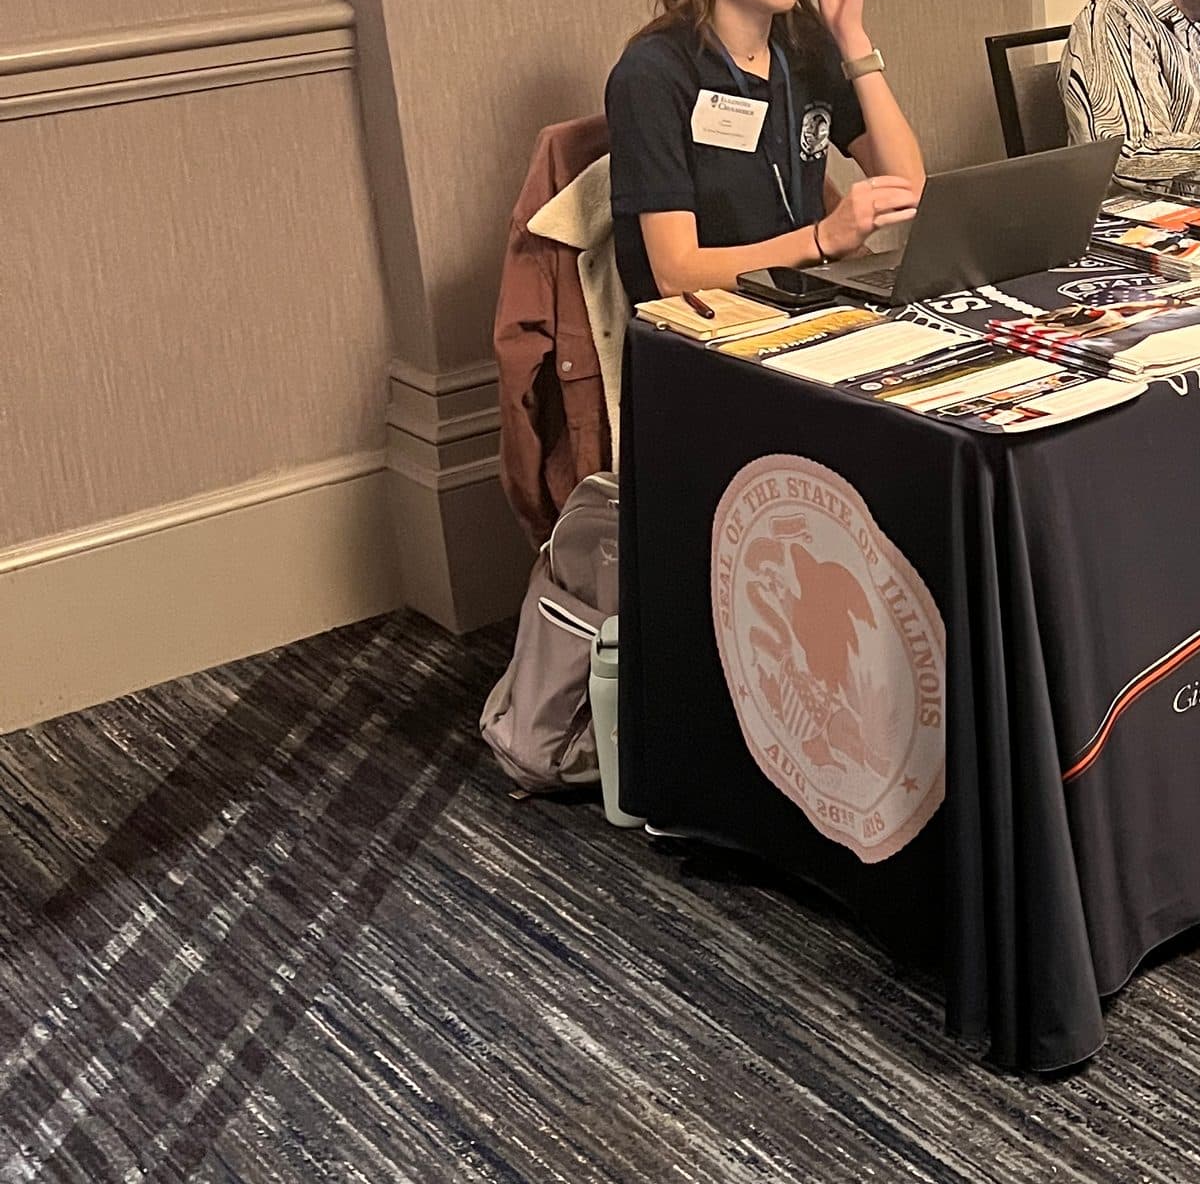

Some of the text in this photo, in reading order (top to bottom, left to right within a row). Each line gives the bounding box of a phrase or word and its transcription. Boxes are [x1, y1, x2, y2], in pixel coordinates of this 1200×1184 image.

[726, 510, 744, 546] OF
[742, 477, 781, 513] THE
[786, 476, 854, 528] STATE
[858, 527, 880, 566] OF
[879, 575, 942, 730] ILLINOIS
